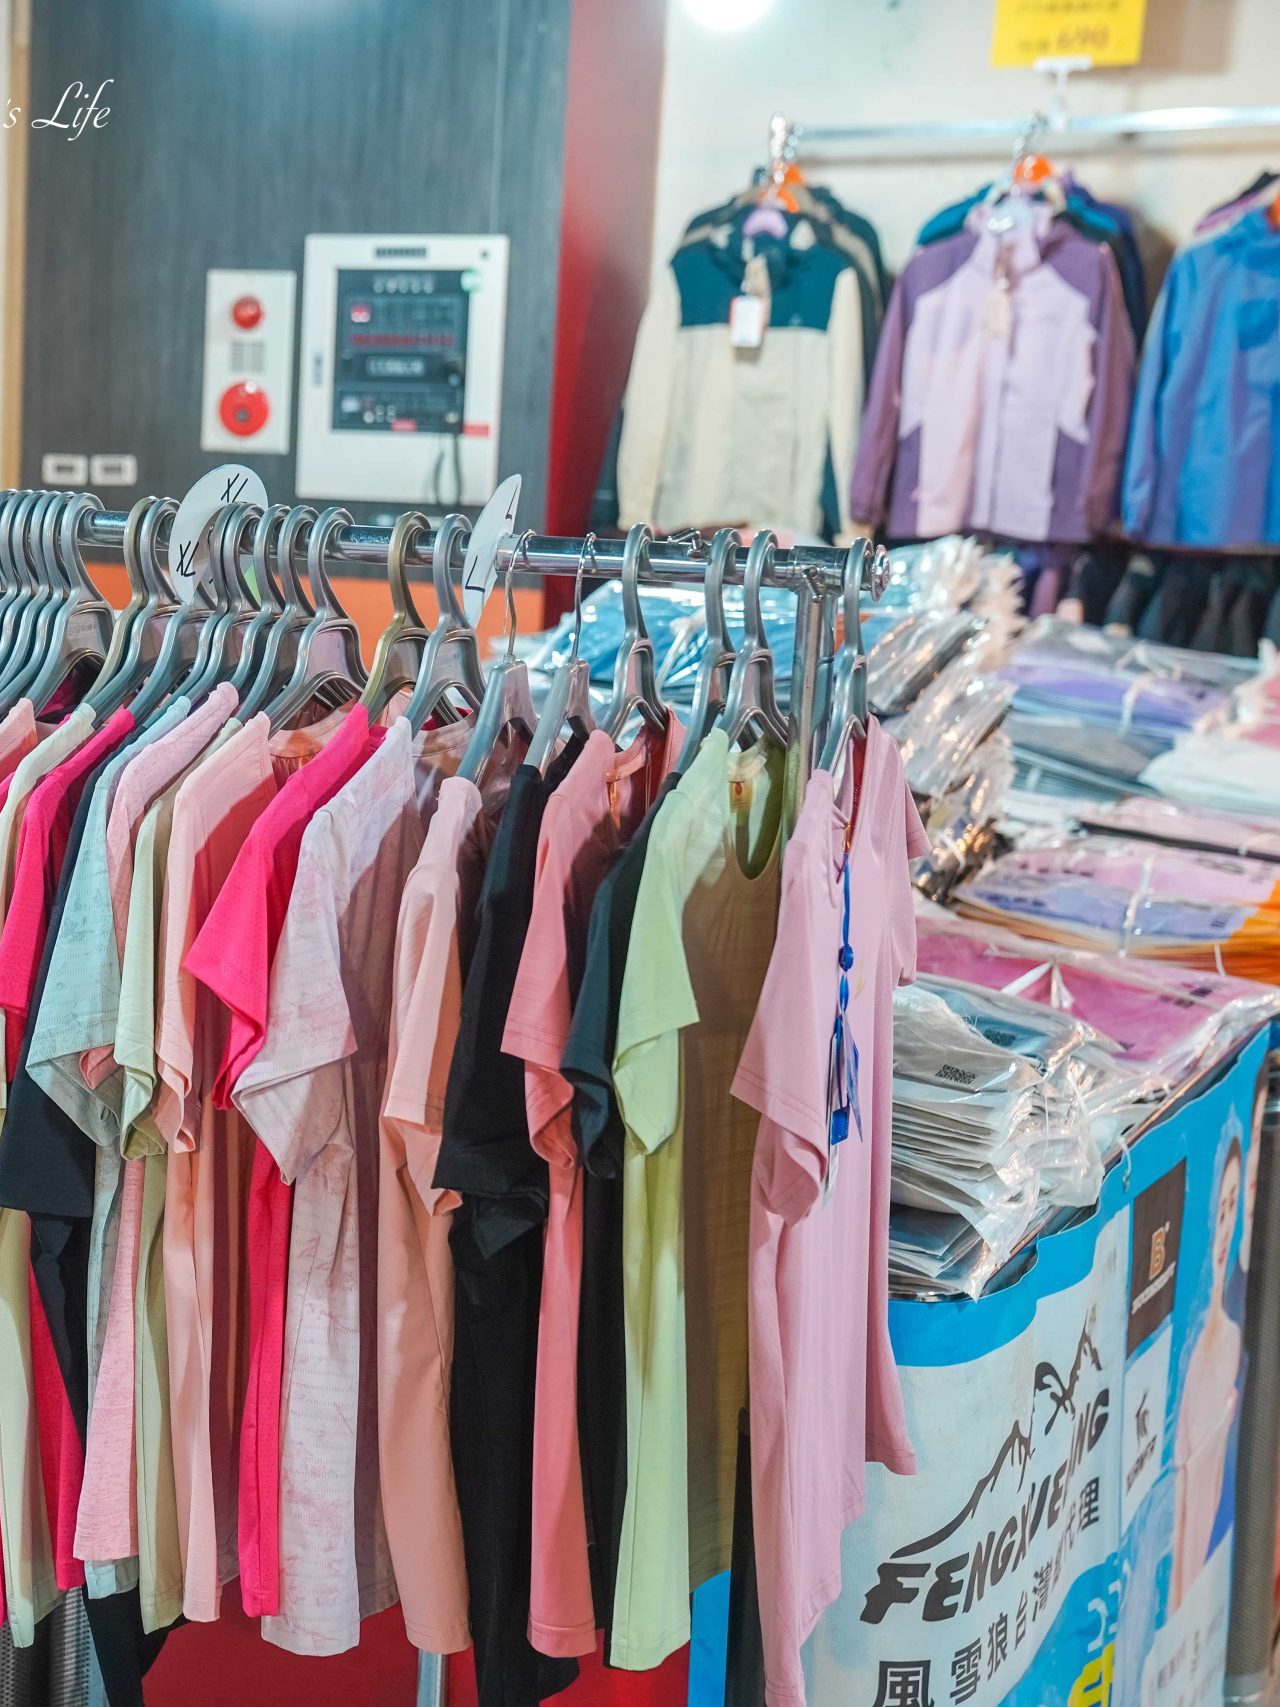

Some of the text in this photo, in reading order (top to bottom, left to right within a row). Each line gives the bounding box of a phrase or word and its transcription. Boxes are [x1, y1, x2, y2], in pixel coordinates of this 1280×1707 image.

[176, 540, 200, 577] XL
[465, 555, 486, 593] L
[859, 1388, 1110, 1625] FENGXUENG
